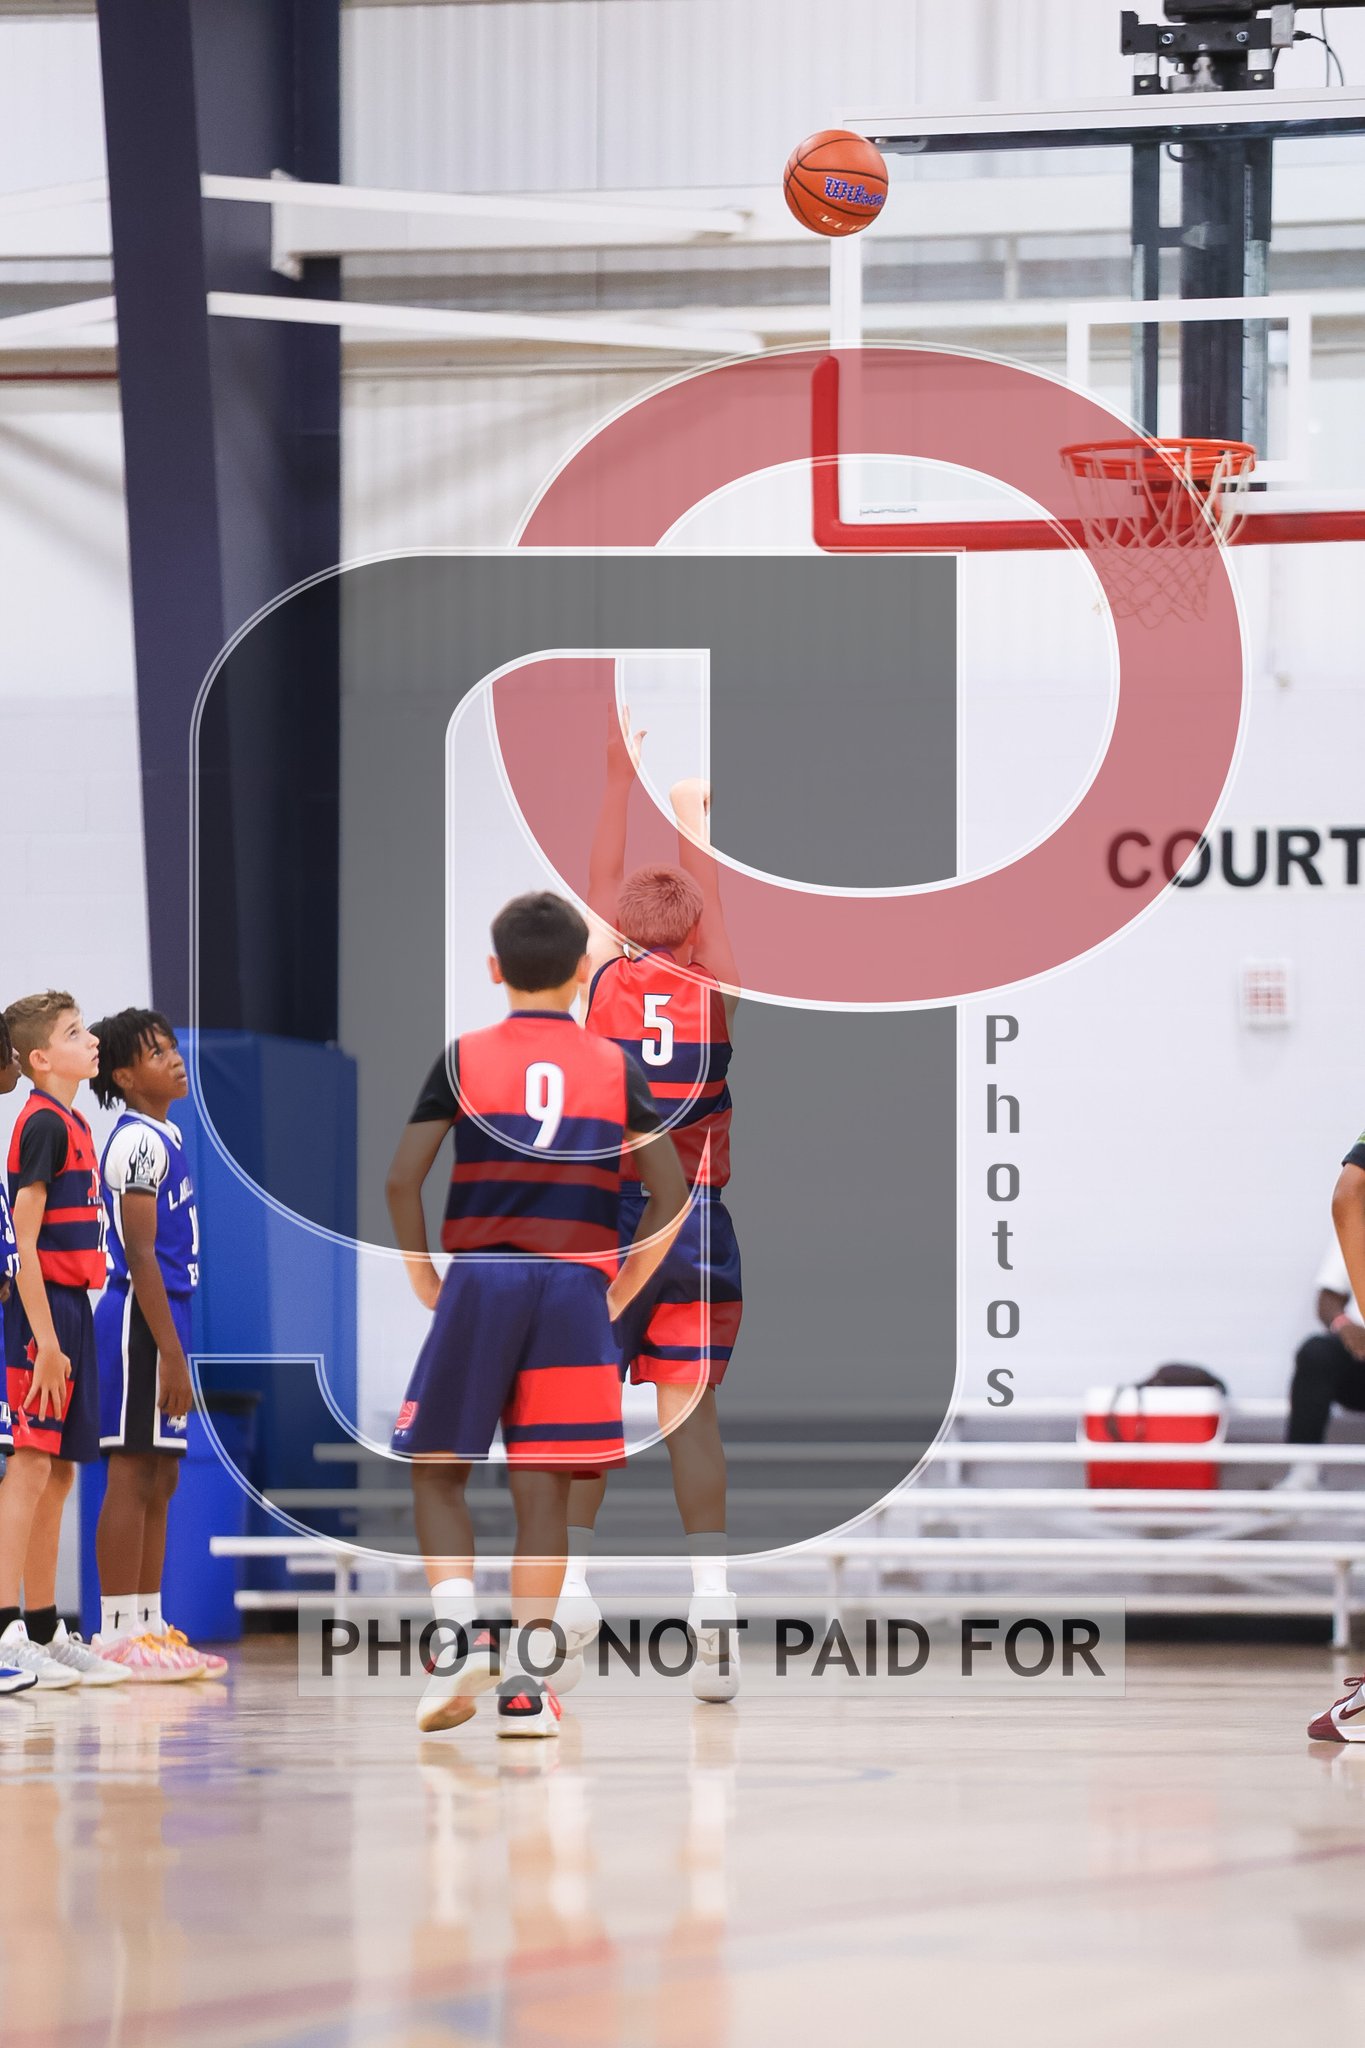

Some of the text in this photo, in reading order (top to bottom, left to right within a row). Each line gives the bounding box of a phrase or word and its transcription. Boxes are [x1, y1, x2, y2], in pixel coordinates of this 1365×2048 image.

[1107, 829, 1365, 889] COURT
[641, 993, 675, 1067] 5
[524, 1061, 565, 1150] 9
